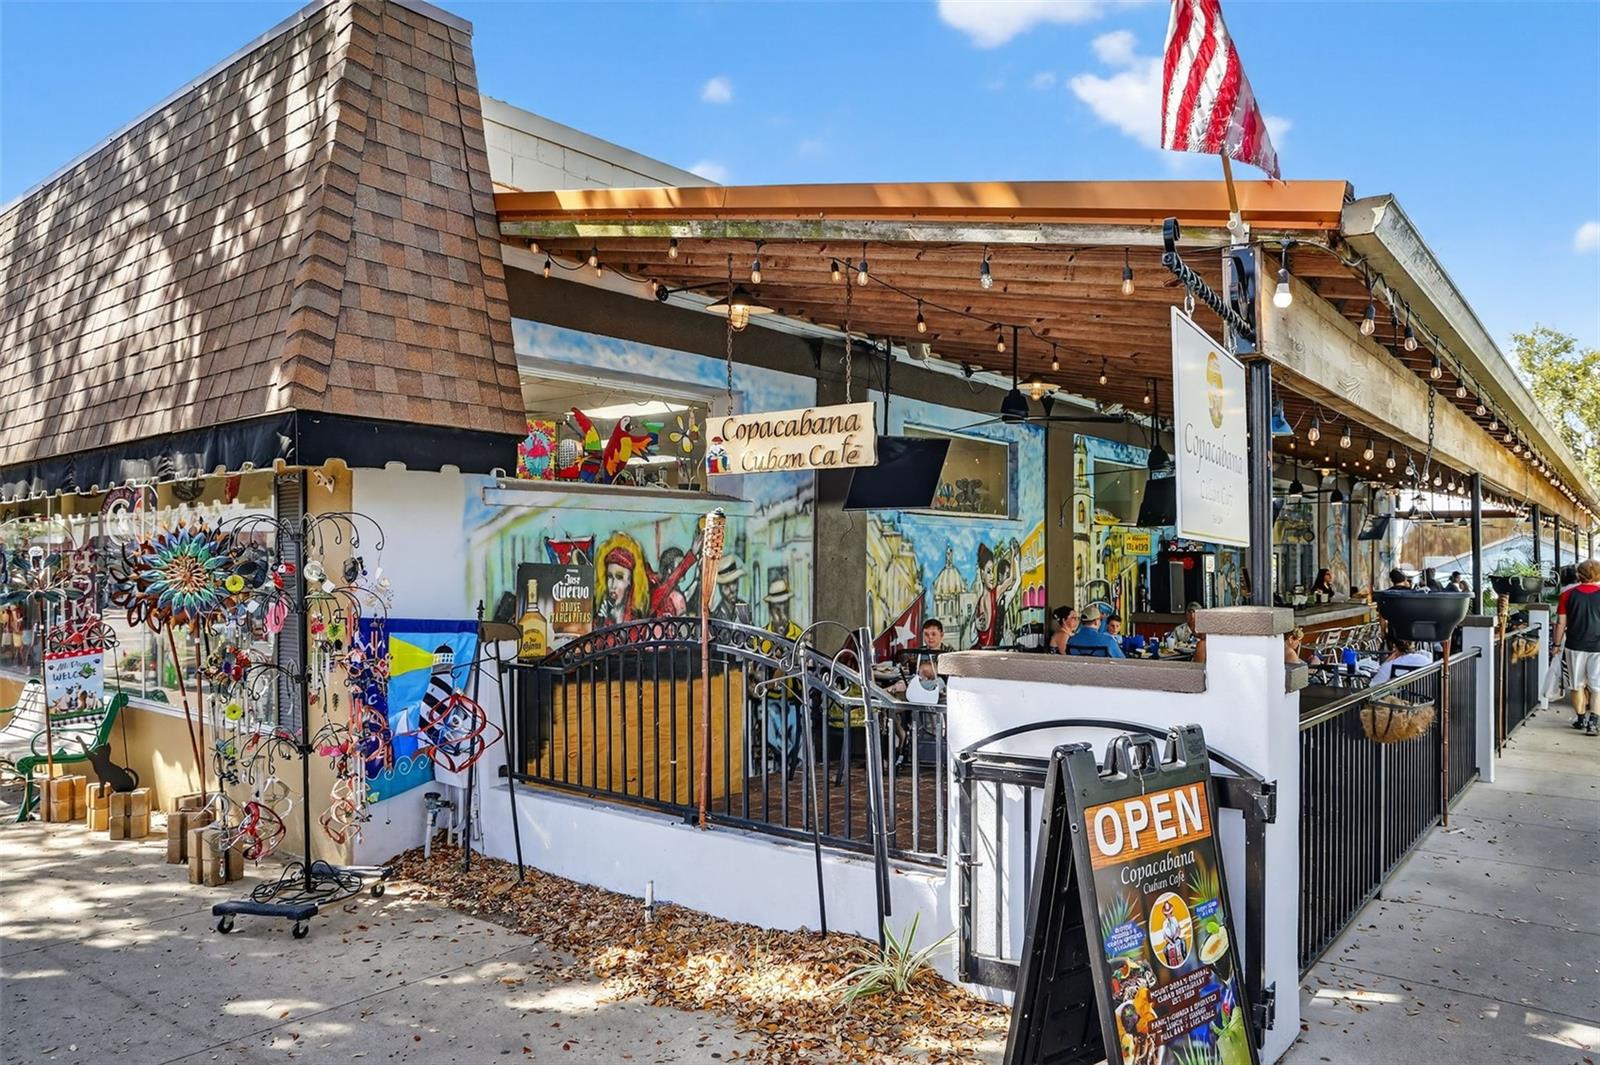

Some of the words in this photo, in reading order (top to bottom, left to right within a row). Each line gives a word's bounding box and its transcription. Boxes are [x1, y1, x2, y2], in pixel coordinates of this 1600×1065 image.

[722, 409, 861, 446] Copacabana
[742, 447, 804, 471] Cuban
[1185, 423, 1243, 475] Copacabana
[552, 581, 589, 601] Cuervo
[1094, 786, 1203, 856] OPEN
[1121, 850, 1195, 888] Copacabana
[1143, 880, 1168, 894] Cuban
